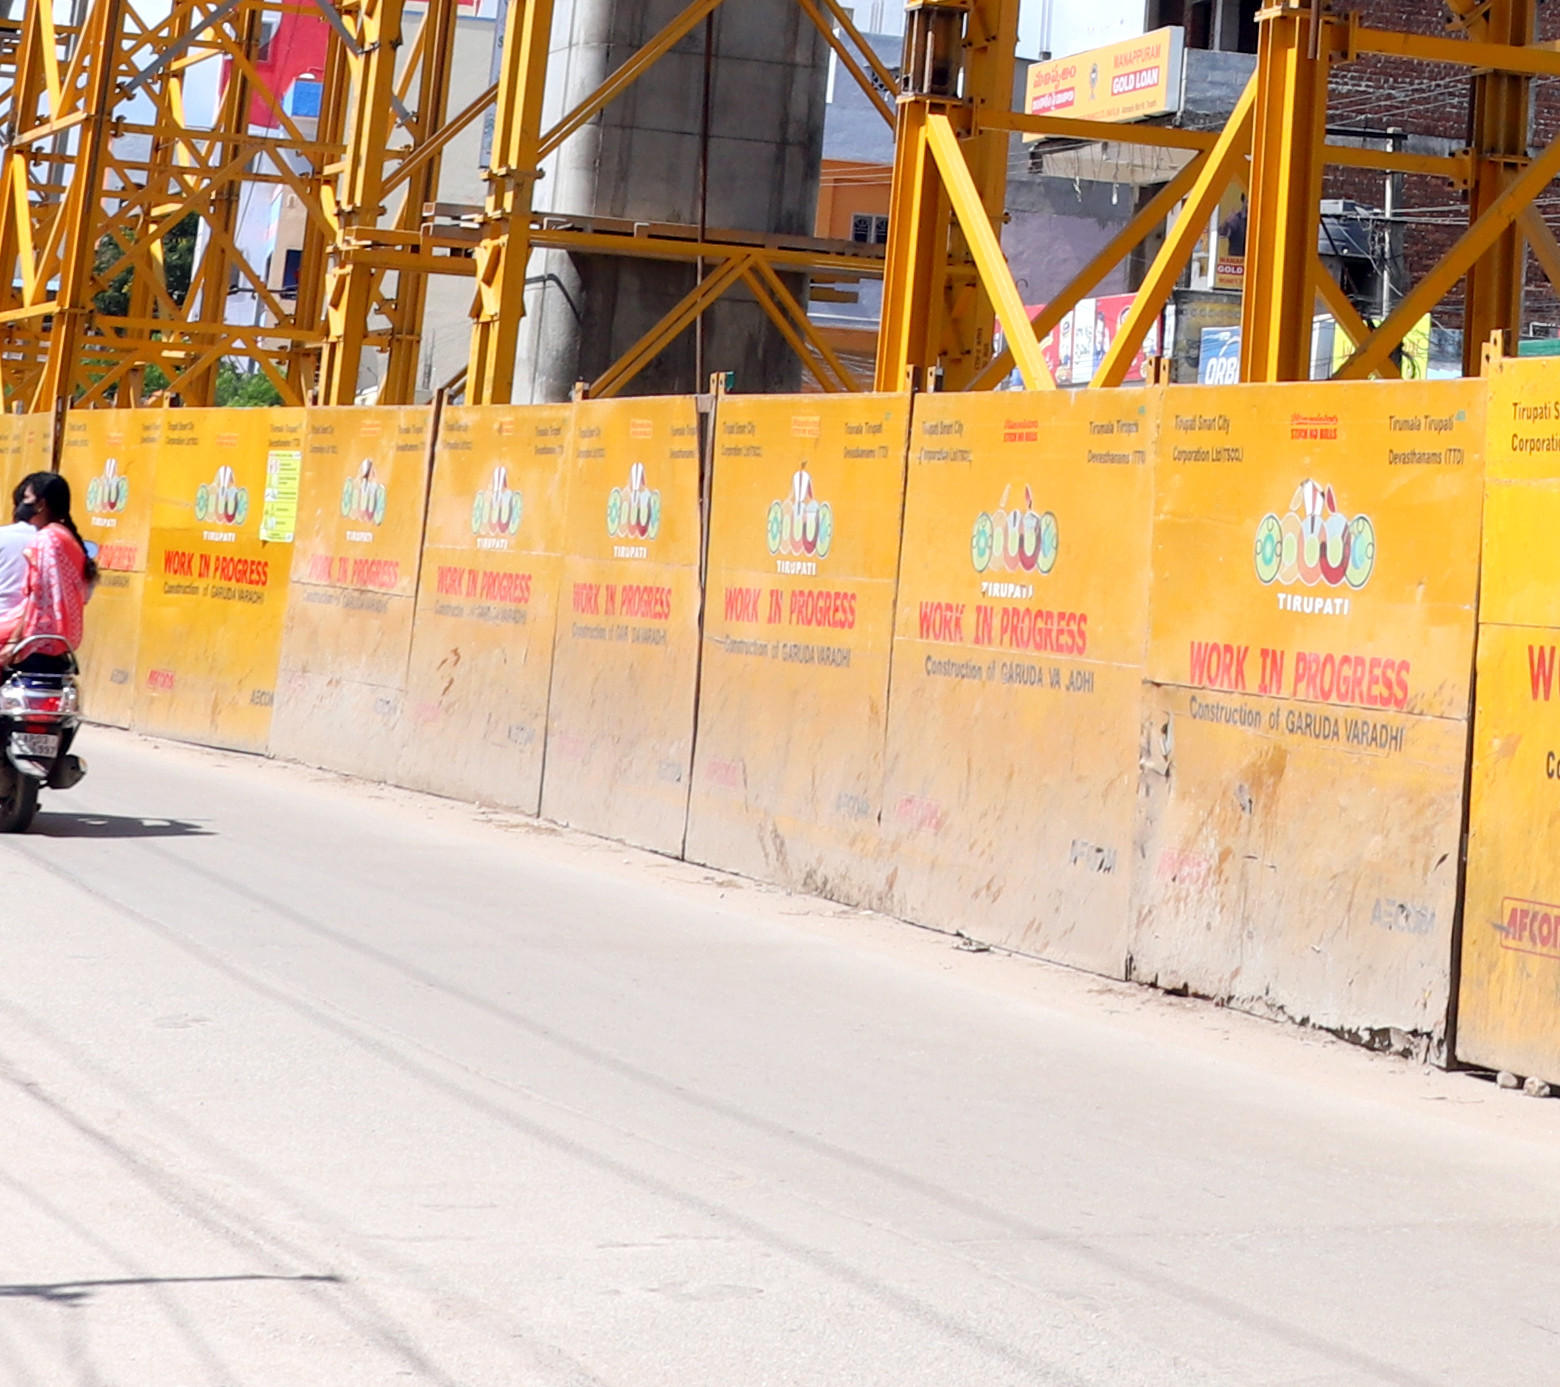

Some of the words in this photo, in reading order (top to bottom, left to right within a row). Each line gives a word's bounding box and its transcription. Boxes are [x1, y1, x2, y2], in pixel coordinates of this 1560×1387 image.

[1113, 43, 1162, 69] MANAPPURAM
[1113, 75, 1134, 95] GOLD
[1136, 68, 1159, 89] LOAN
[1512, 402, 1550, 423] Tirupati
[1389, 449, 1442, 465] Devasthanams
[203, 530, 236, 542] TIRUPATI
[164, 549, 193, 577] WORK
[198, 552, 211, 578] IN
[214, 555, 269, 587] PROGRESS
[776, 560, 817, 576] TIRUPATI
[572, 582, 600, 615] WORK
[605, 583, 616, 616] IN
[621, 584, 673, 621] PROGRESS
[725, 587, 761, 623] WORK
[767, 589, 783, 625] IN
[791, 590, 857, 630] PROGRESS
[1277, 593, 1350, 615] TIRUPATI
[919, 600, 966, 642] WORK
[973, 604, 994, 645] IN
[999, 606, 1089, 656] PROGRESS
[1190, 641, 1250, 691] WORK
[1258, 647, 1285, 695] IN
[1293, 651, 1410, 710] PROGRESS
[1190, 695, 1262, 727] Construction
[1269, 707, 1280, 731] of
[1286, 709, 1340, 742] GARUDA
[1345, 718, 1406, 752] VARADHI
